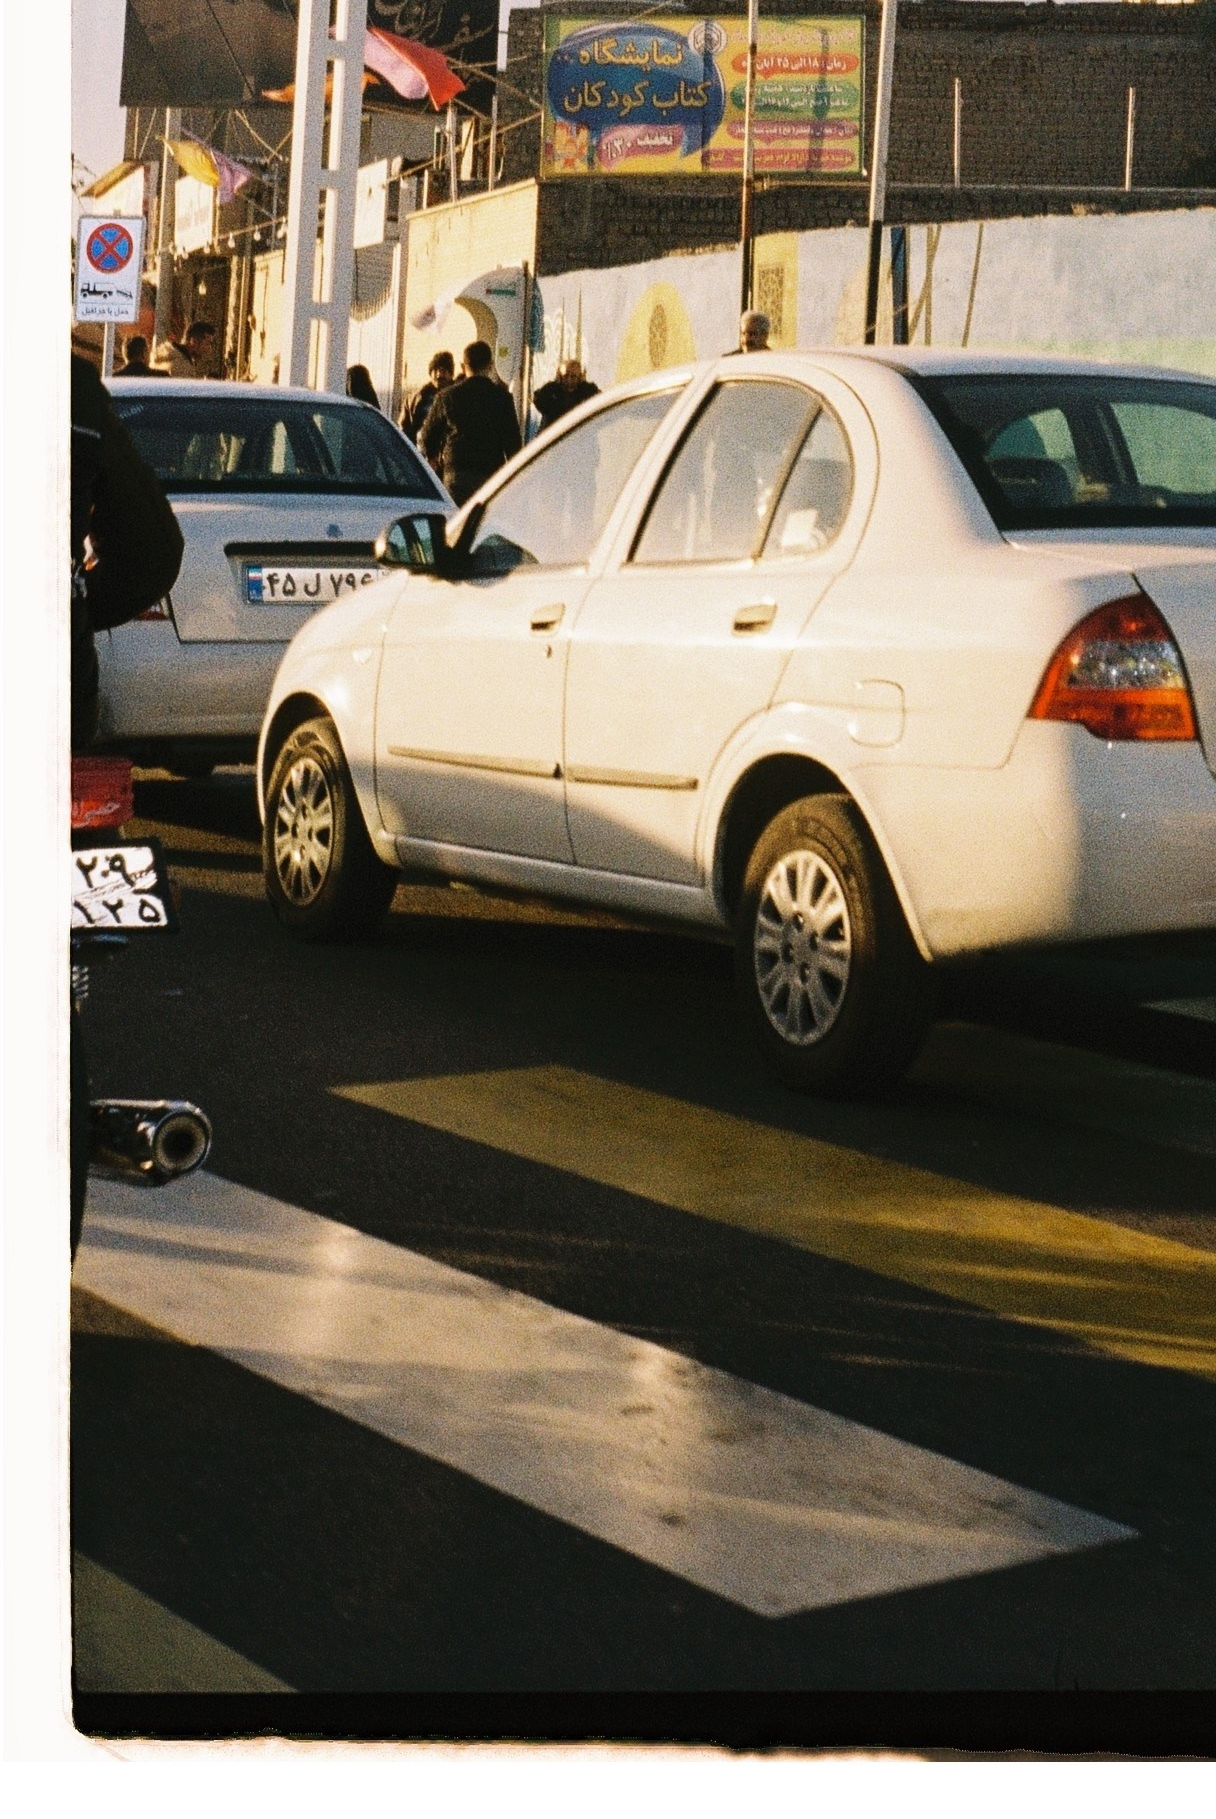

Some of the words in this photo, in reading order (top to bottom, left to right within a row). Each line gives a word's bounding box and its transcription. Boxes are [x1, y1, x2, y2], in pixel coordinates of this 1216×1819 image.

[578, 37, 684, 72] نمایشگاه
[563, 80, 650, 117] کودکان
[652, 79, 713, 117] کتاب
[267, 572, 297, 597] ۴۵
[303, 572, 321, 597] ل
